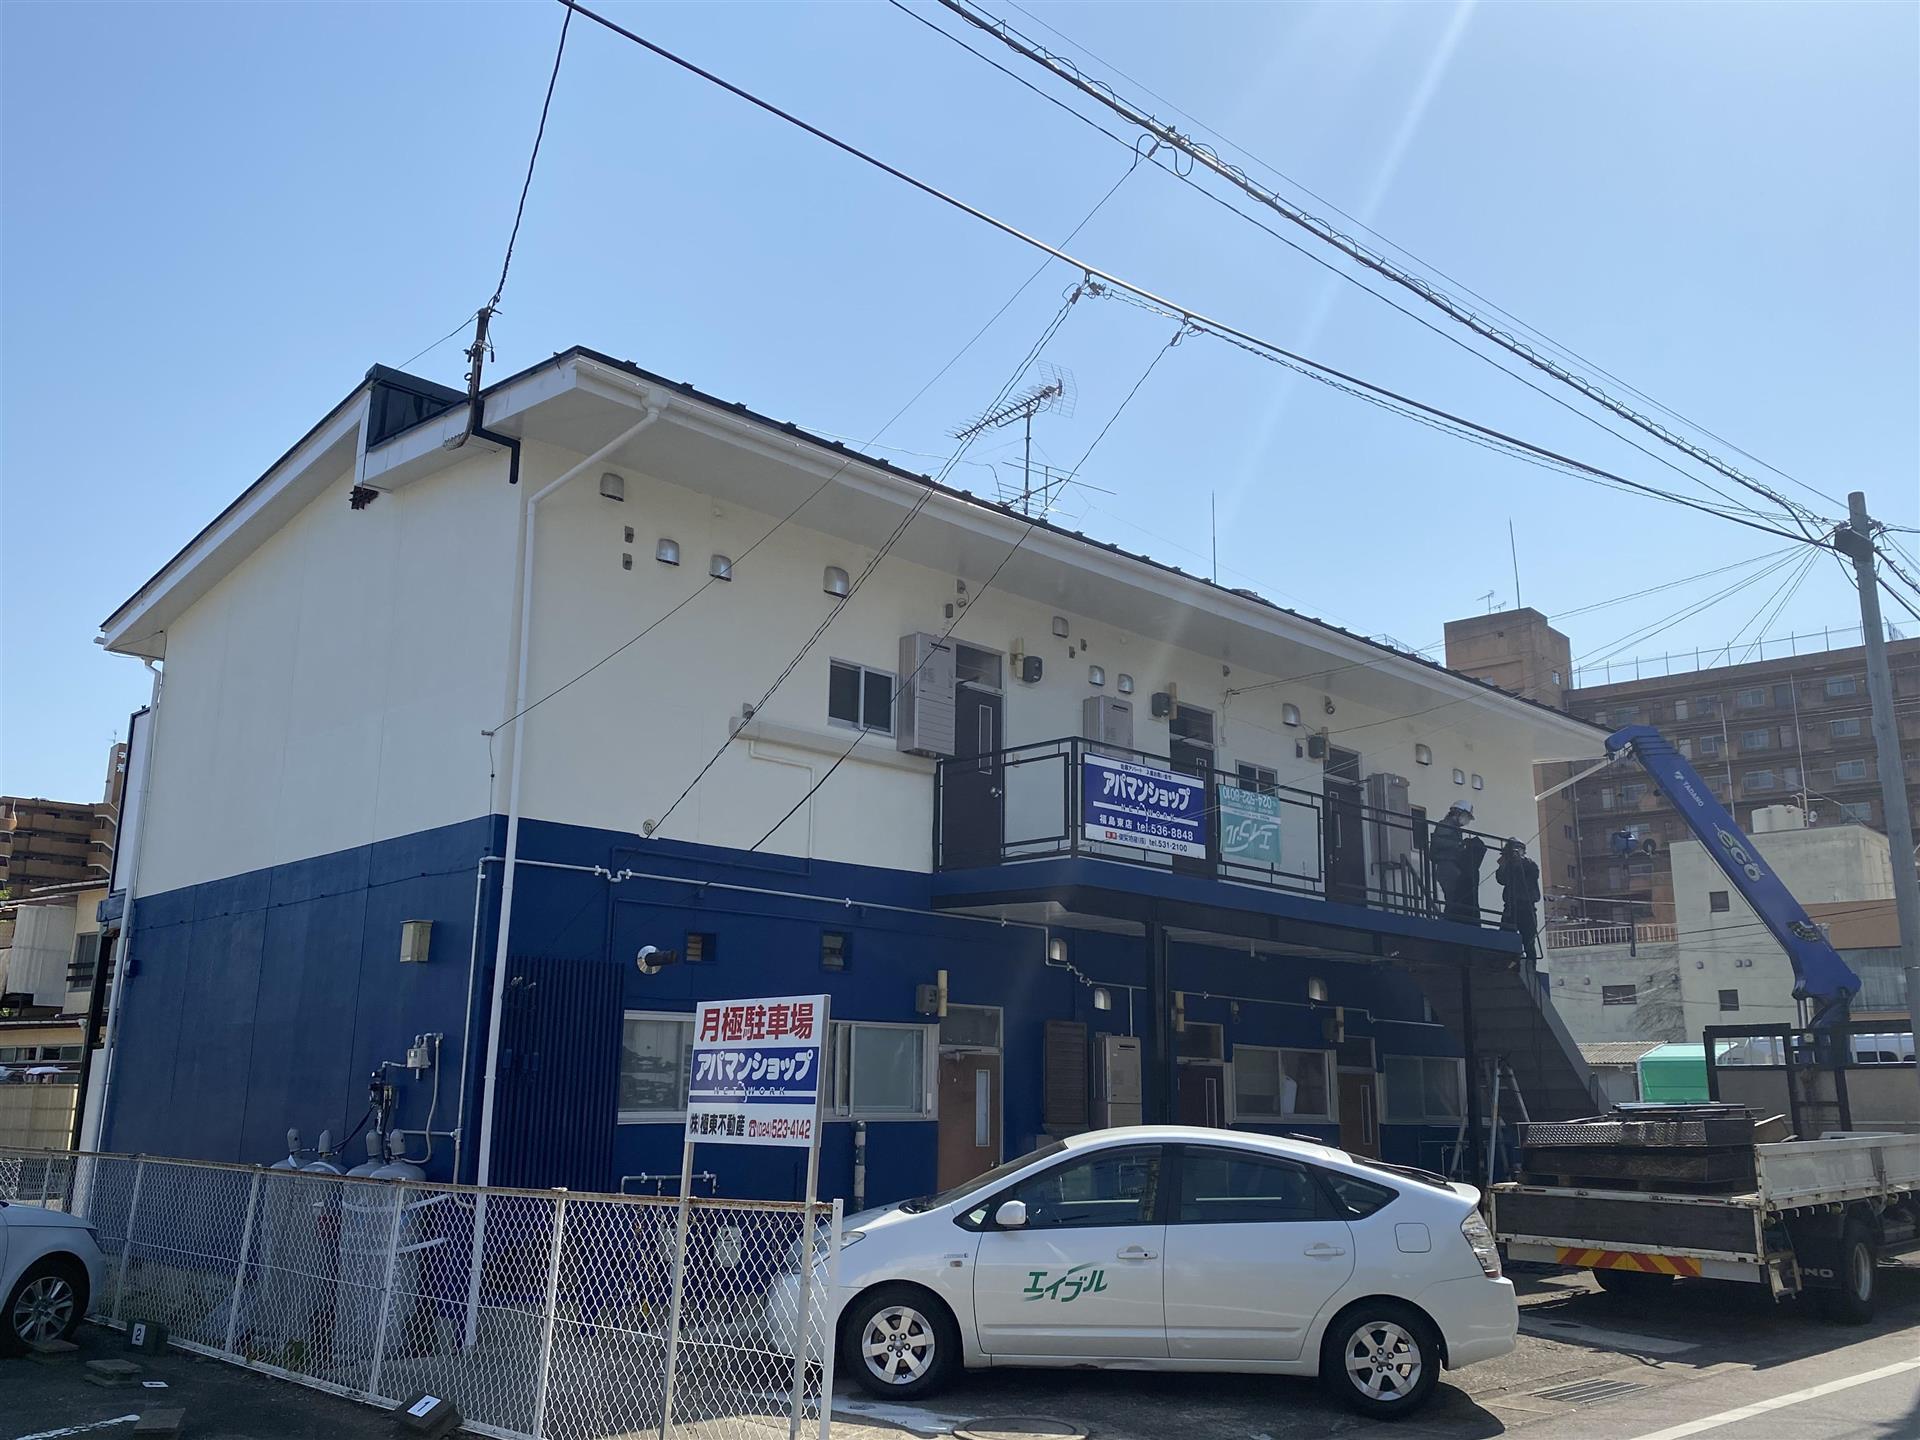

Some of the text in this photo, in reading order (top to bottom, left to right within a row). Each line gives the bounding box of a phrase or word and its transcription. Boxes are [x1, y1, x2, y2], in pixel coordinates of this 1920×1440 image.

[1103, 771, 1190, 810] アパマンショップ
[1682, 780, 1705, 807] TADANO
[1099, 813, 1133, 831] 福島東店
[1136, 822, 1194, 841] tel.536-8848
[1225, 820, 1275, 852] エイブル
[699, 1003, 814, 1042] 月極駐車場
[695, 1049, 814, 1081] アパマンショップ
[1024, 1265, 1108, 1302] エイブル
[135, 1327, 143, 1342] 2
